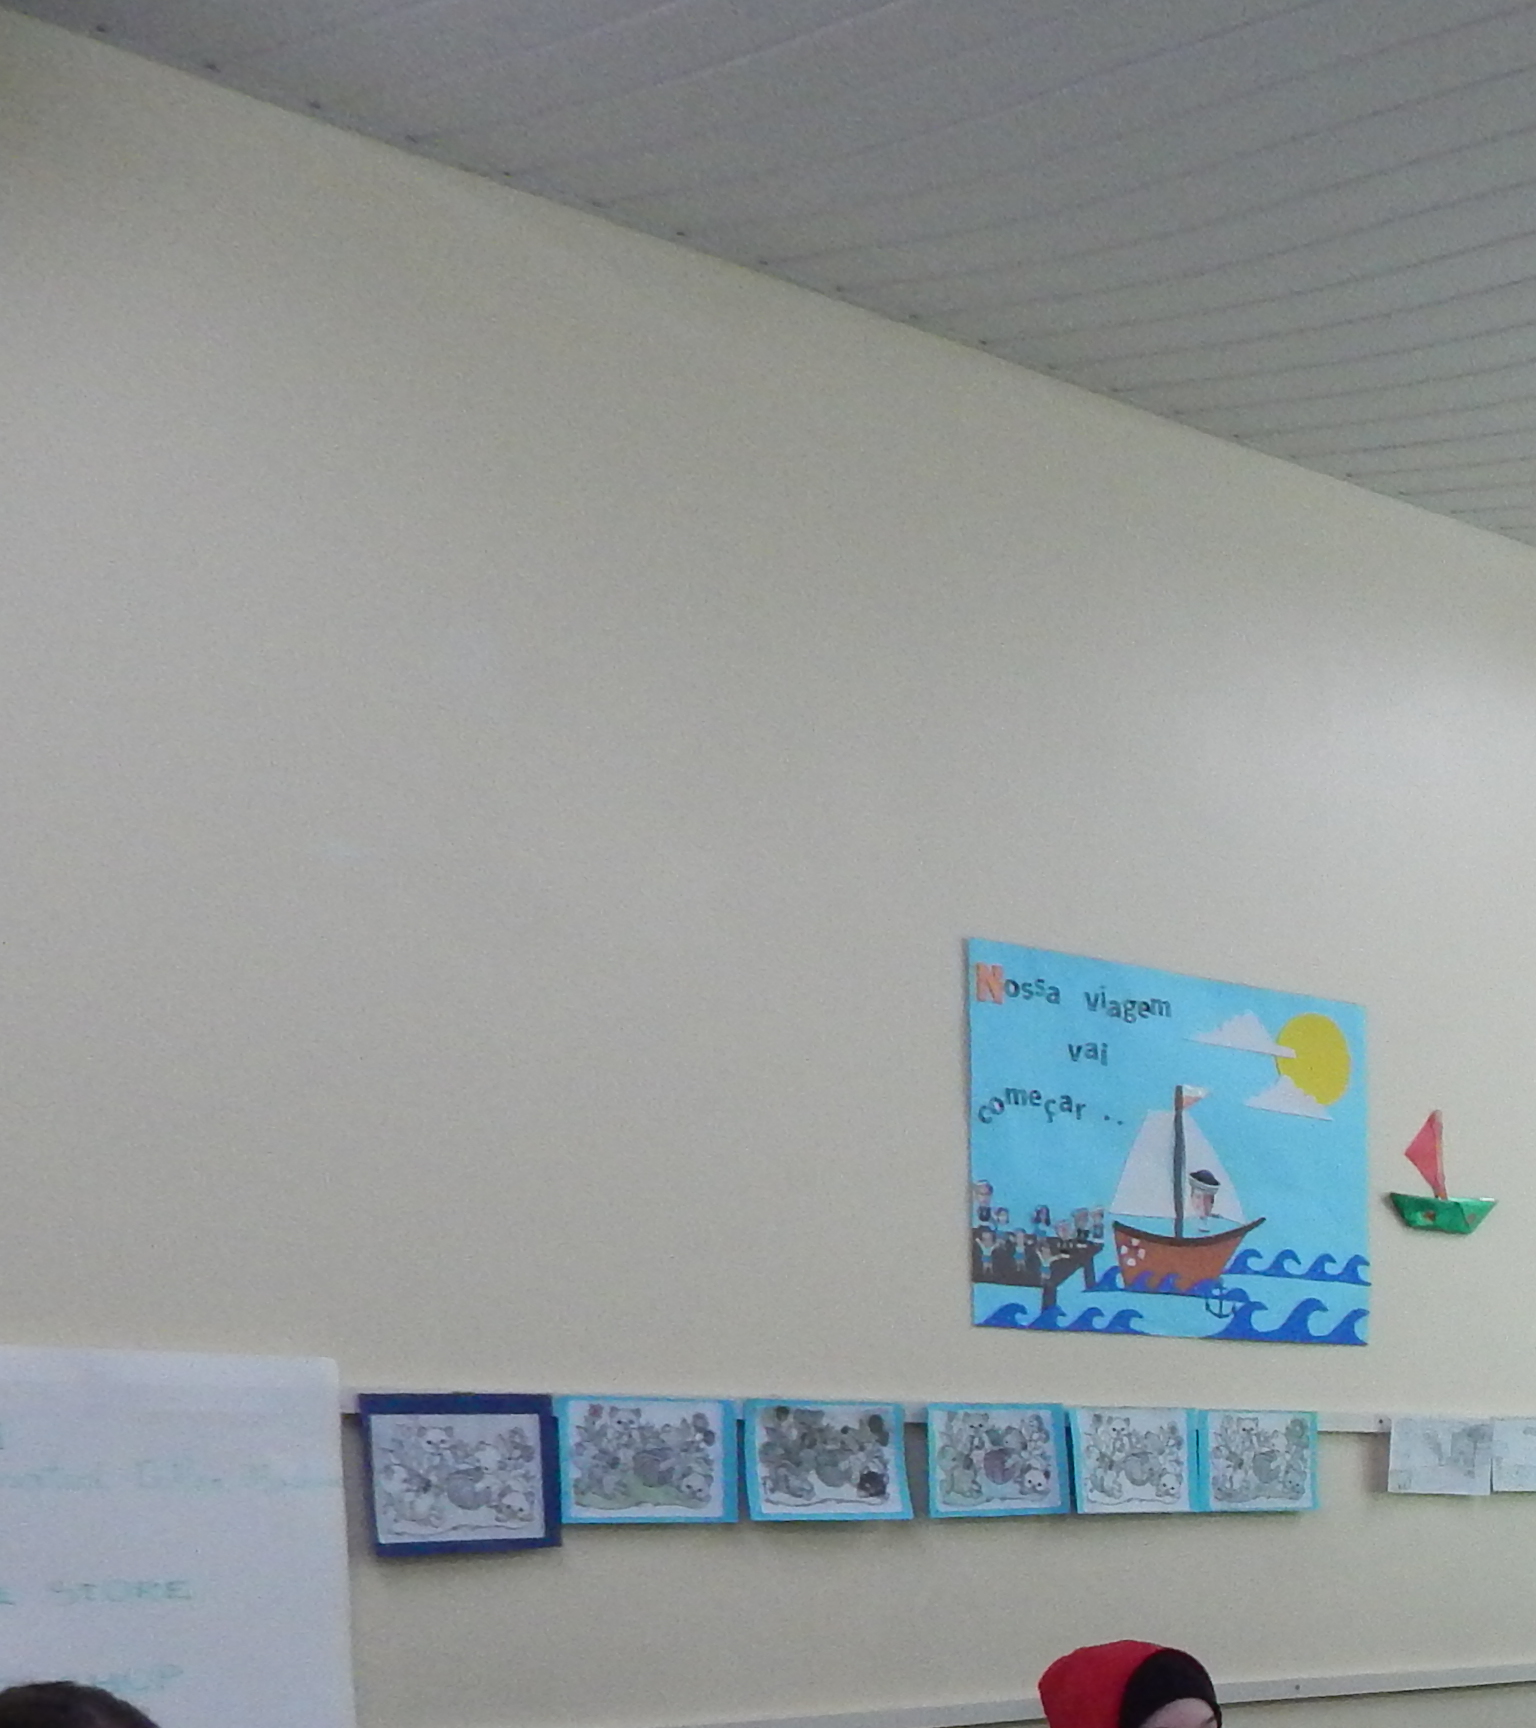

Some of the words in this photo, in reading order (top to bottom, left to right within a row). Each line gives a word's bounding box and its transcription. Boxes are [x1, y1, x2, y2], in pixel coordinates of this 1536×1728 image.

[975, 962, 1061, 1005] Nossa
[1084, 985, 1171, 1023] viagem
[1067, 1042, 1108, 1066] vai
